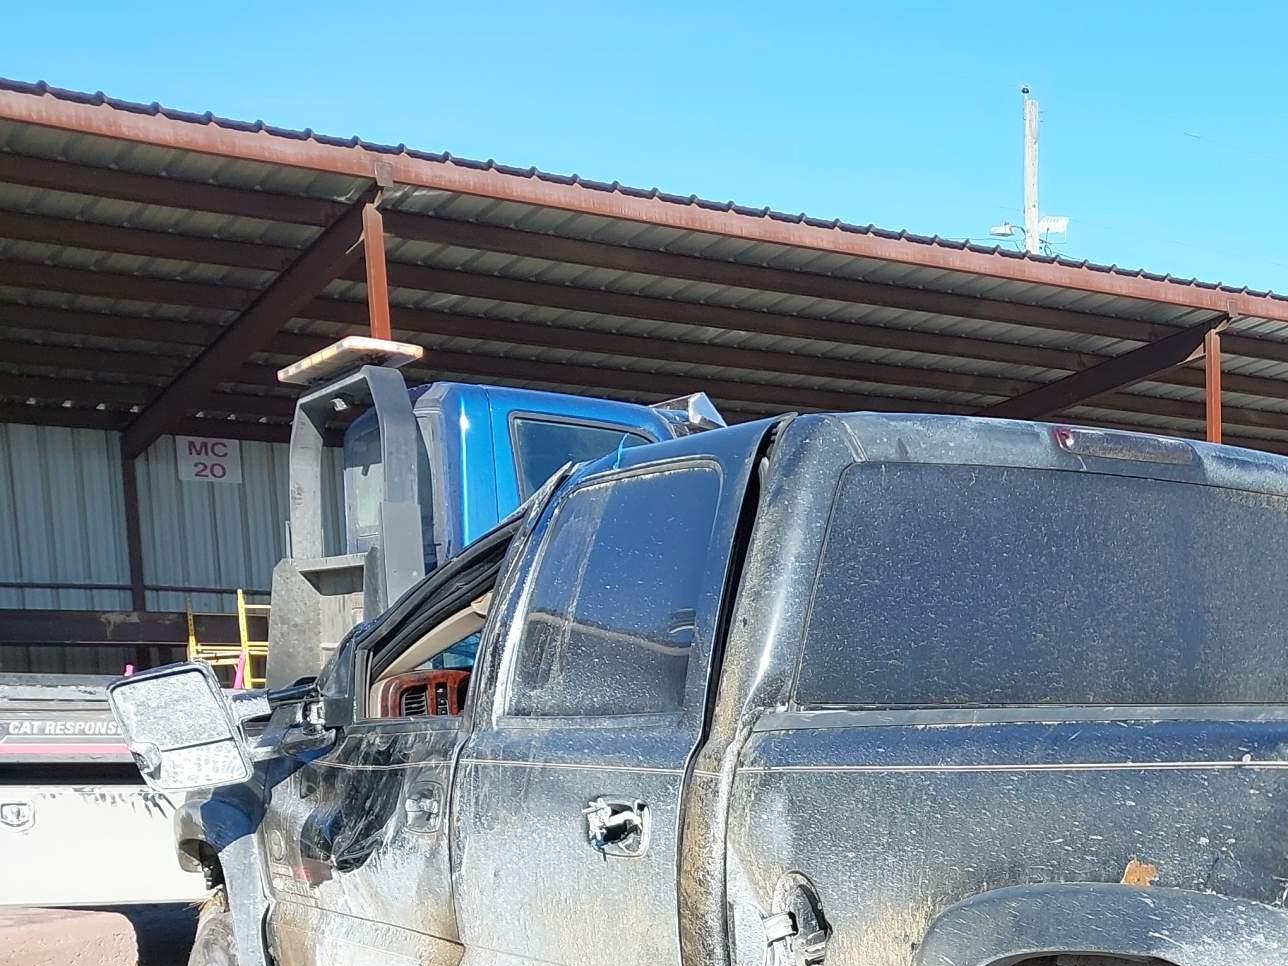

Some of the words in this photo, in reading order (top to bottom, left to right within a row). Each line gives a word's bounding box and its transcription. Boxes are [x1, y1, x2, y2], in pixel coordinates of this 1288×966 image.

[188, 440, 228, 458] MC
[193, 462, 226, 478] 20
[8, 721, 42, 735] CAT
